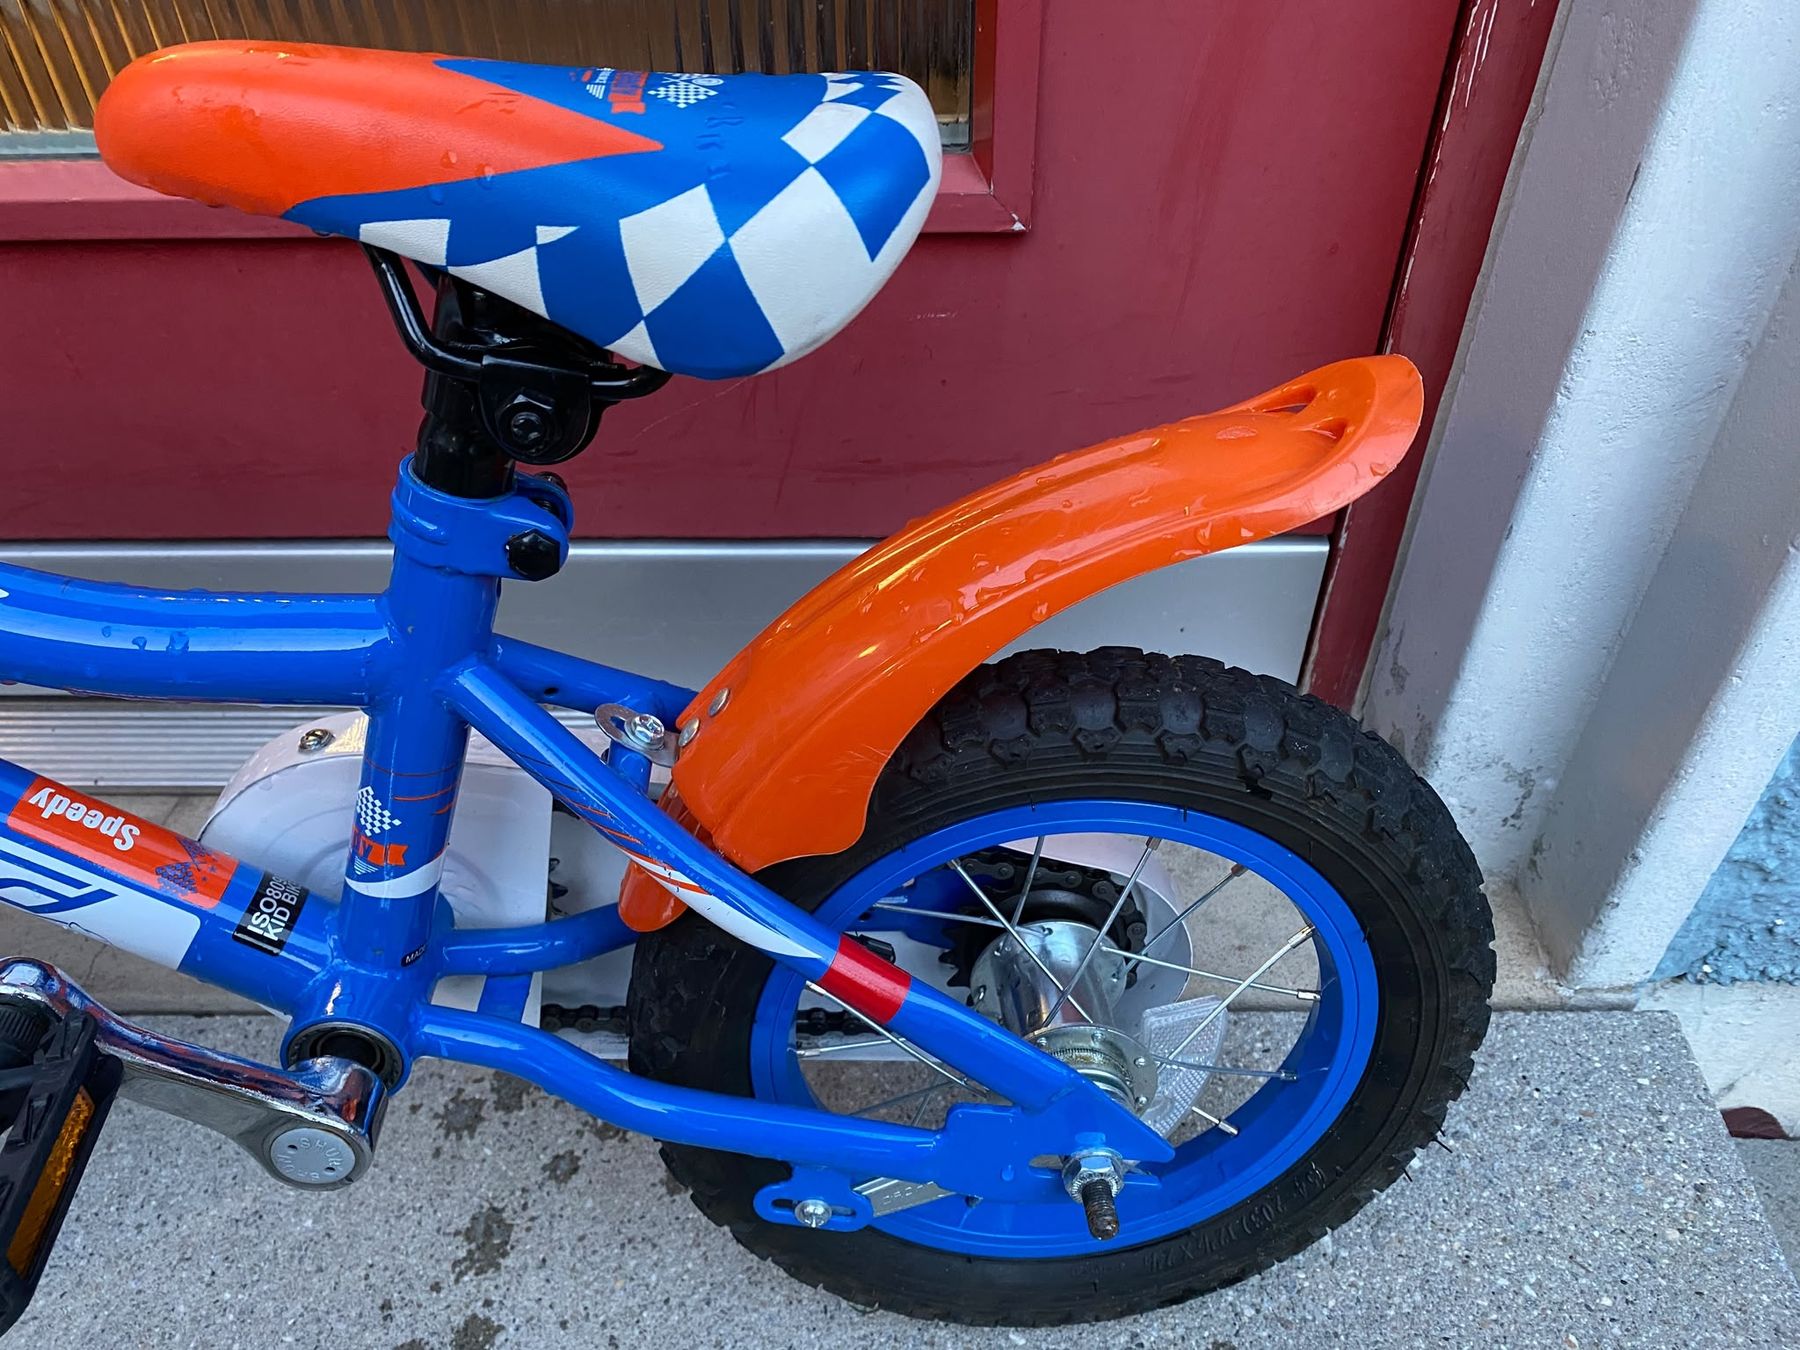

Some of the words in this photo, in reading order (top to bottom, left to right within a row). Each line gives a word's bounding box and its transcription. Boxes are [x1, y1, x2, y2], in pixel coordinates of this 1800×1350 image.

[28, 787, 140, 851] Speedy
[247, 873, 287, 935] ISO809
[264, 906, 290, 941] KID
[282, 879, 302, 905] BIK
